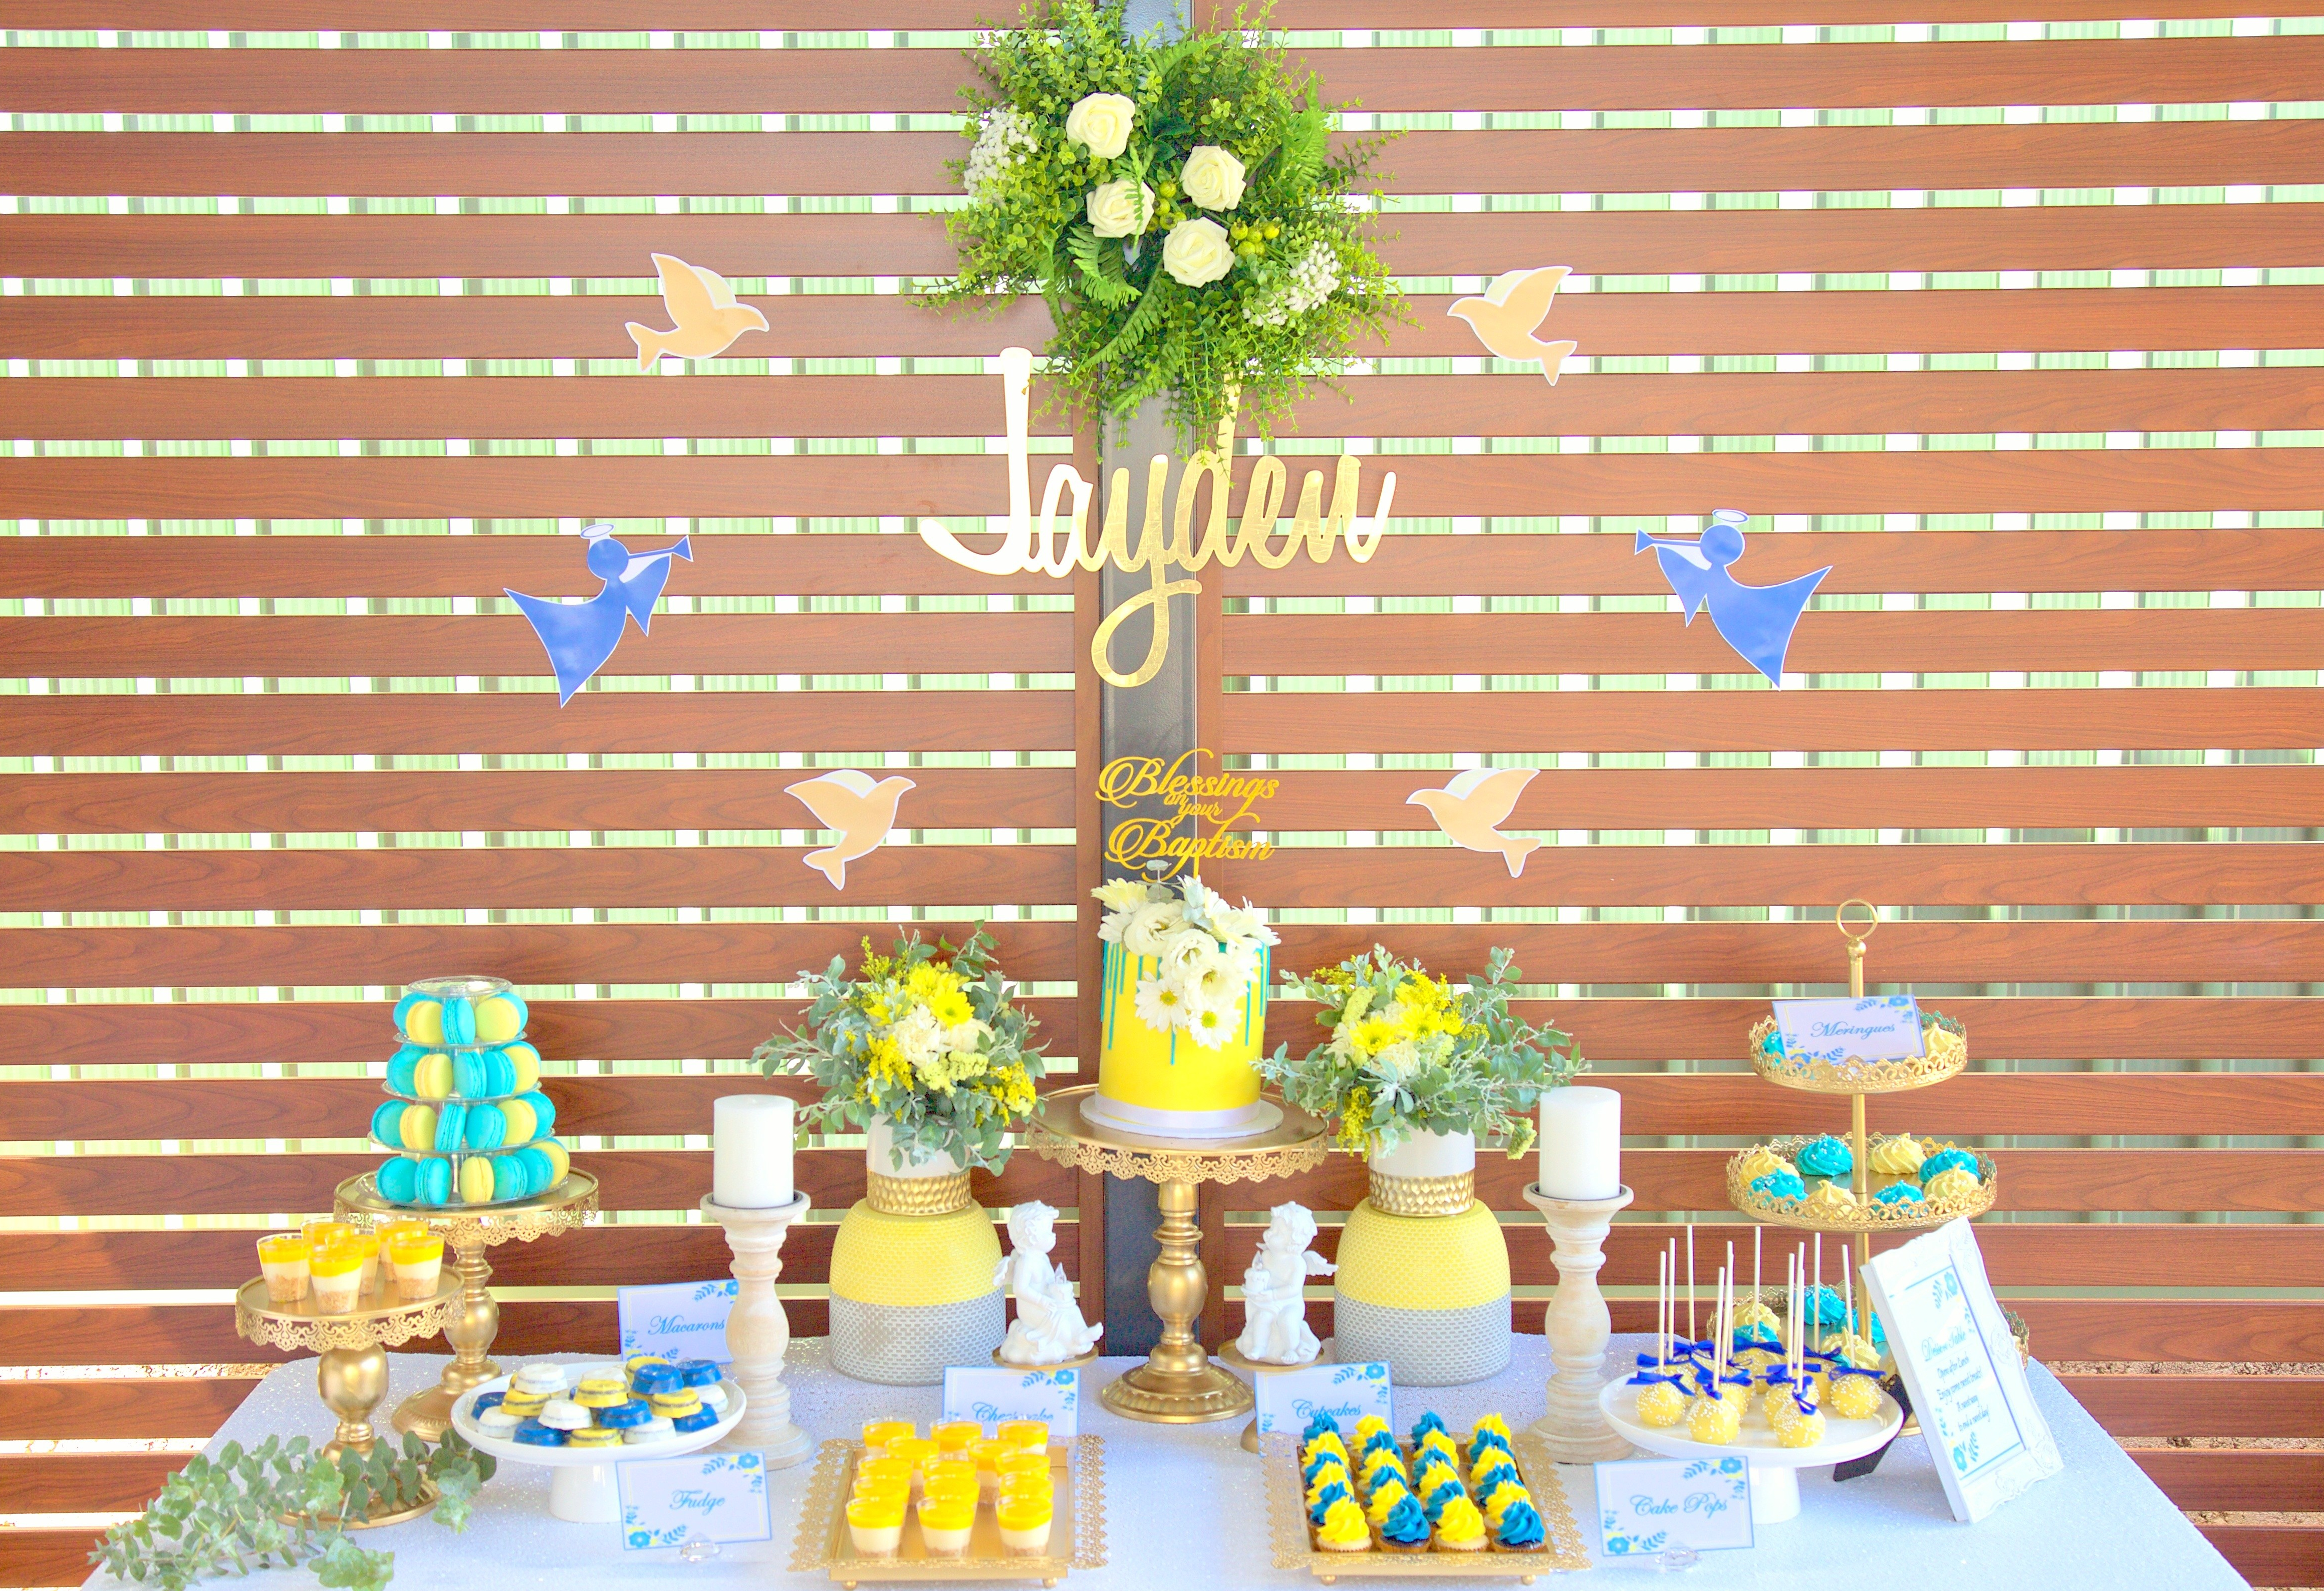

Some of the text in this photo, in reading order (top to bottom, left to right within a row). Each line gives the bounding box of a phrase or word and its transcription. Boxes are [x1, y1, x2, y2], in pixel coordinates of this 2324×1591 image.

[919, 347, 1397, 688] Jayden
[1095, 748, 1279, 825] Blessings
[1163, 792, 1189, 805] on
[1170, 802, 1223, 826] your
[1104, 818, 1275, 883] Baptism
[1811, 1021, 1896, 1040] Meringues
[648, 1315, 725, 1335] Macarons
[1947, 1325, 1966, 1348] Table
[1936, 1389, 1953, 1404] Enjoy
[1960, 1372, 1971, 1389] sweet
[1292, 1399, 1361, 1419] Cupcakes
[1956, 1400, 1962, 1412] A
[1972, 1409, 1982, 1424] sweet
[669, 1489, 725, 1516] Fudge
[1629, 1492, 1727, 1519] Cake Pops
